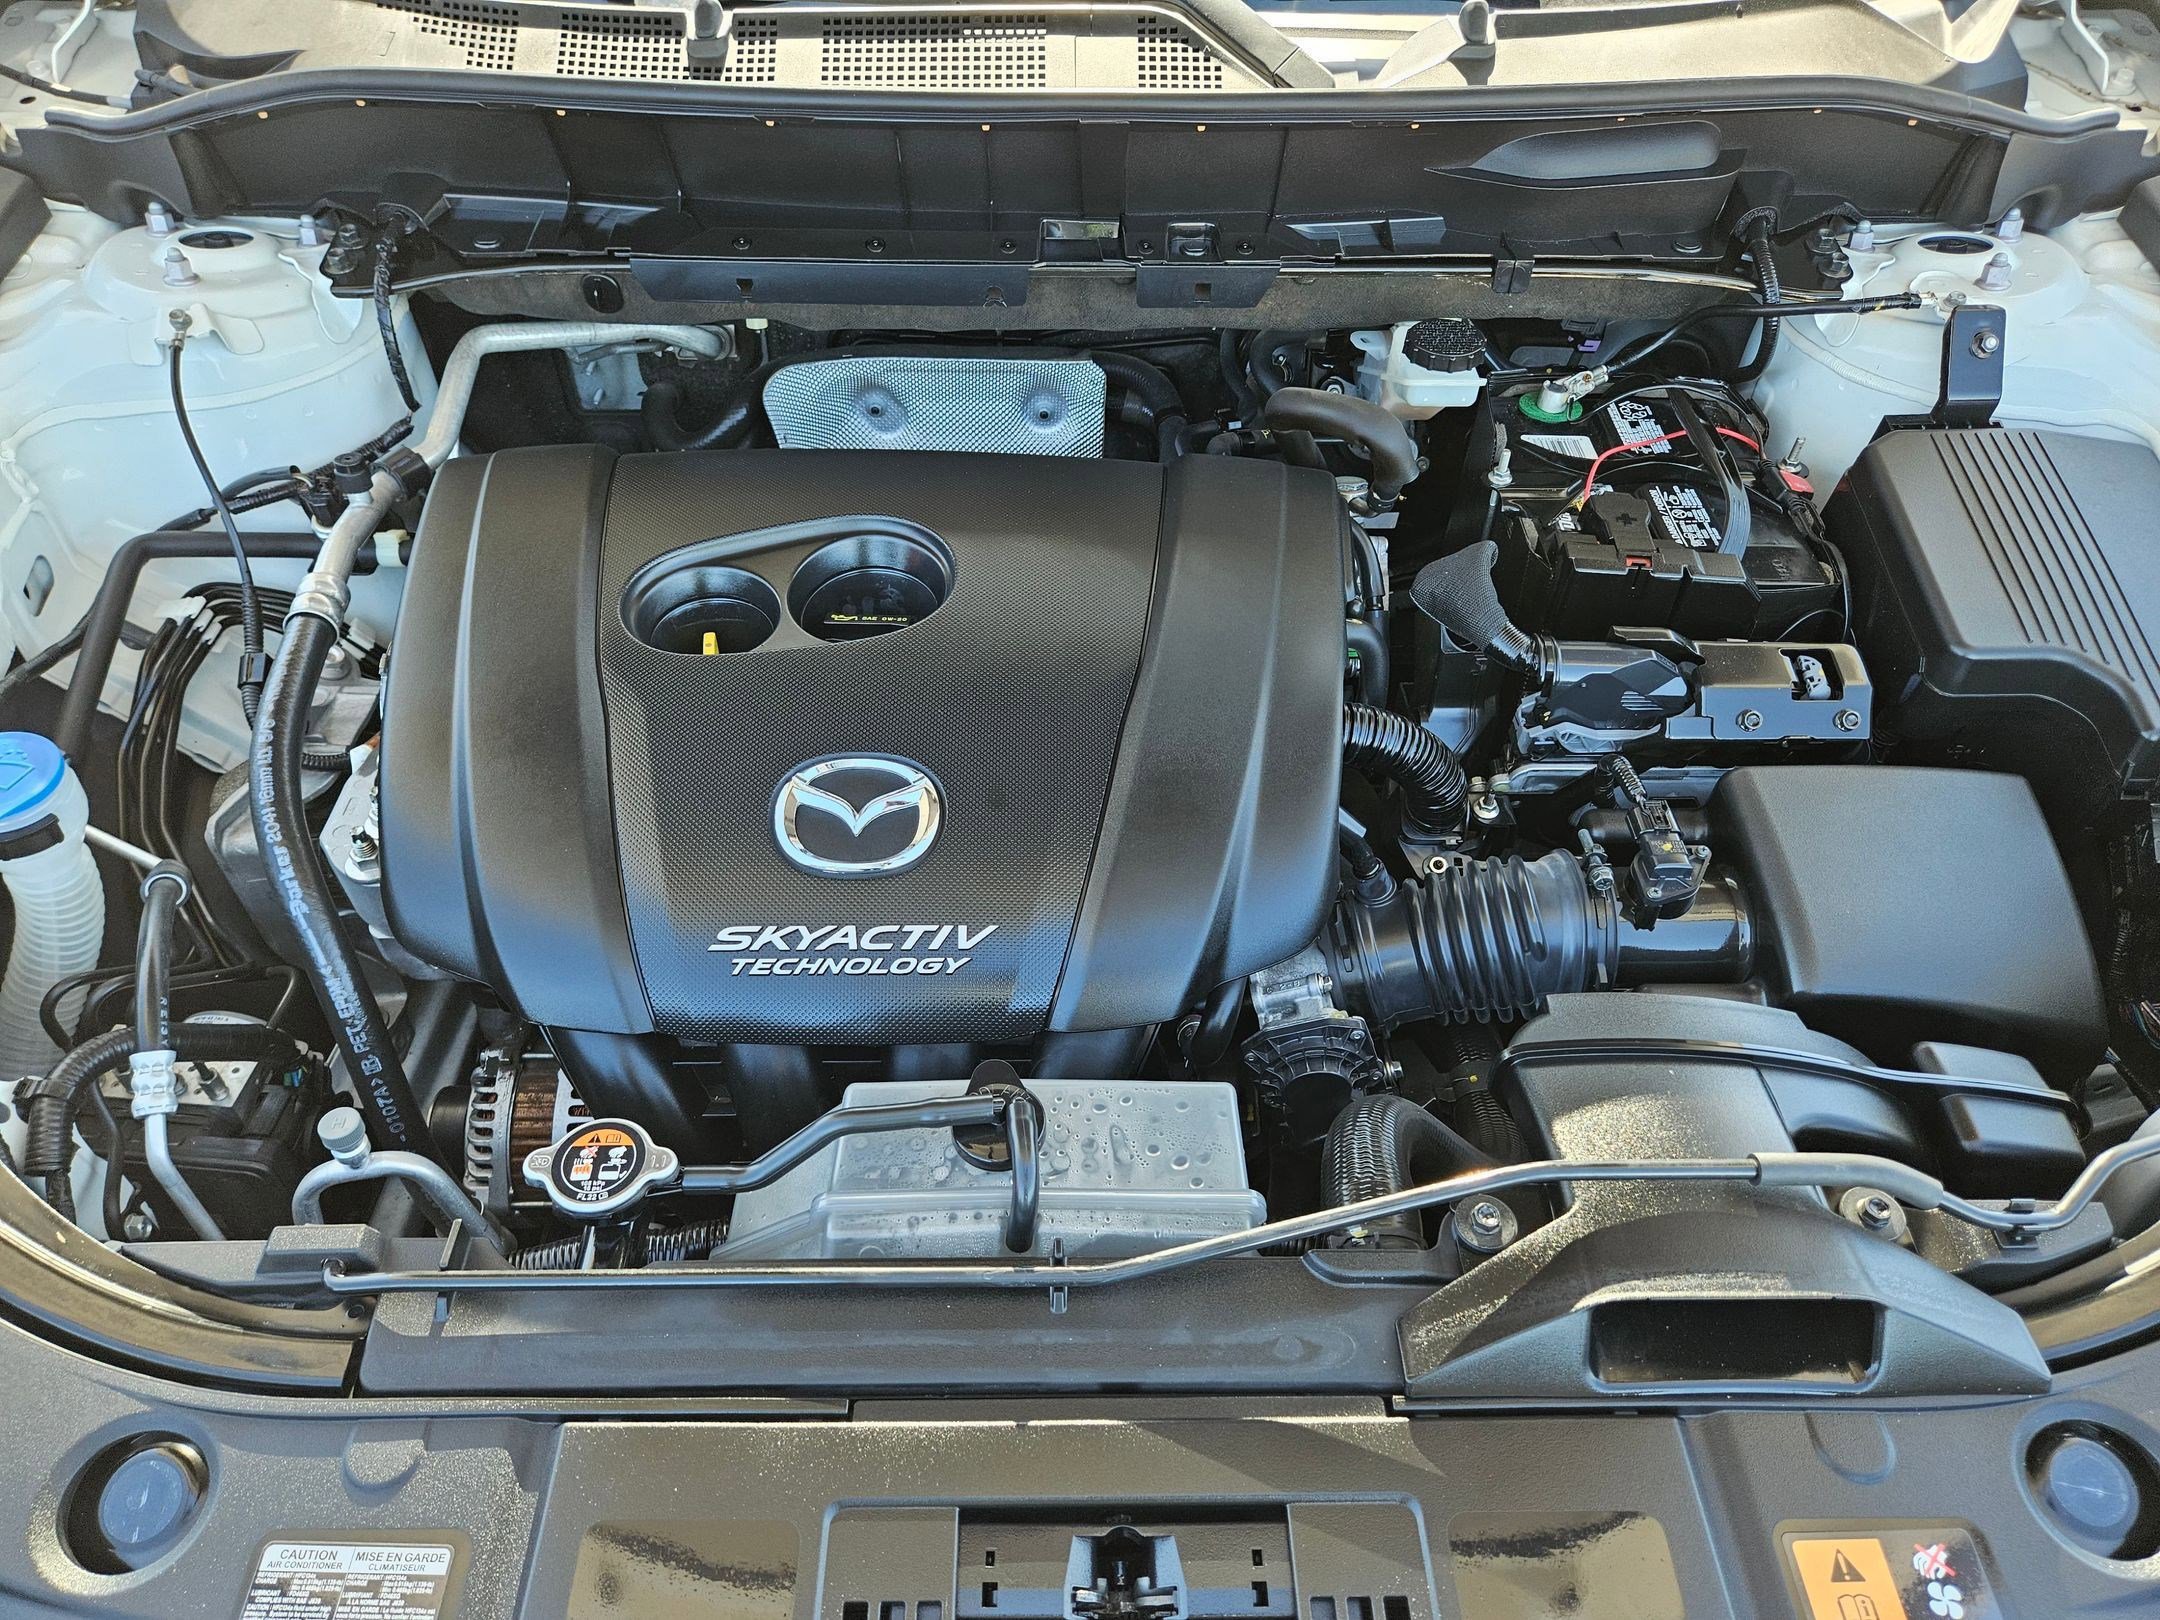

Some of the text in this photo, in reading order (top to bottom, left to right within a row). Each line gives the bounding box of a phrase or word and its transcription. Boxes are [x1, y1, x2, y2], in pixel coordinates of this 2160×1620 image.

[258, 767, 275, 804] 16mm
[261, 806, 282, 843] 2041
[707, 924, 1000, 951] SKYACTIV
[730, 957, 972, 975] TECHNOLOGY
[576, 1192, 598, 1201] FL22
[280, 1549, 338, 1560] CAUTION
[355, 1551, 446, 1563] MISE EN GARDE
[267, 1560, 343, 1569] AIR CONDITIONER
[368, 1563, 426, 1572] CLIMATISEUR
